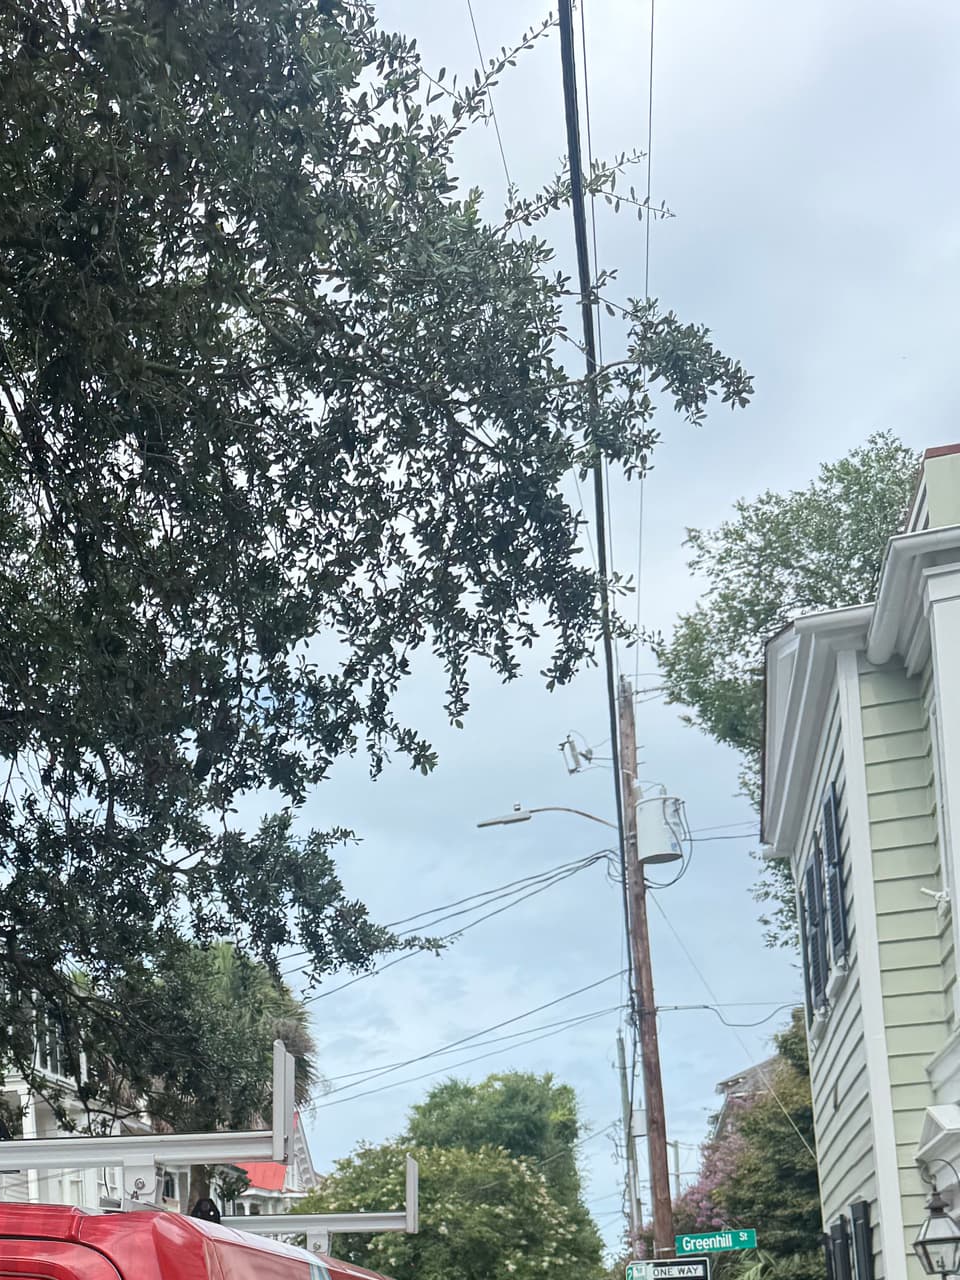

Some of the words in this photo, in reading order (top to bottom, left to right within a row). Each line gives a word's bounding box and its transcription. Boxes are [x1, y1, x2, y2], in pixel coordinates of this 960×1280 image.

[682, 1233, 733, 1251] Greenhill
[739, 1231, 749, 1241] St
[652, 1267, 674, 1277] ONE
[677, 1266, 699, 1275] WAY
